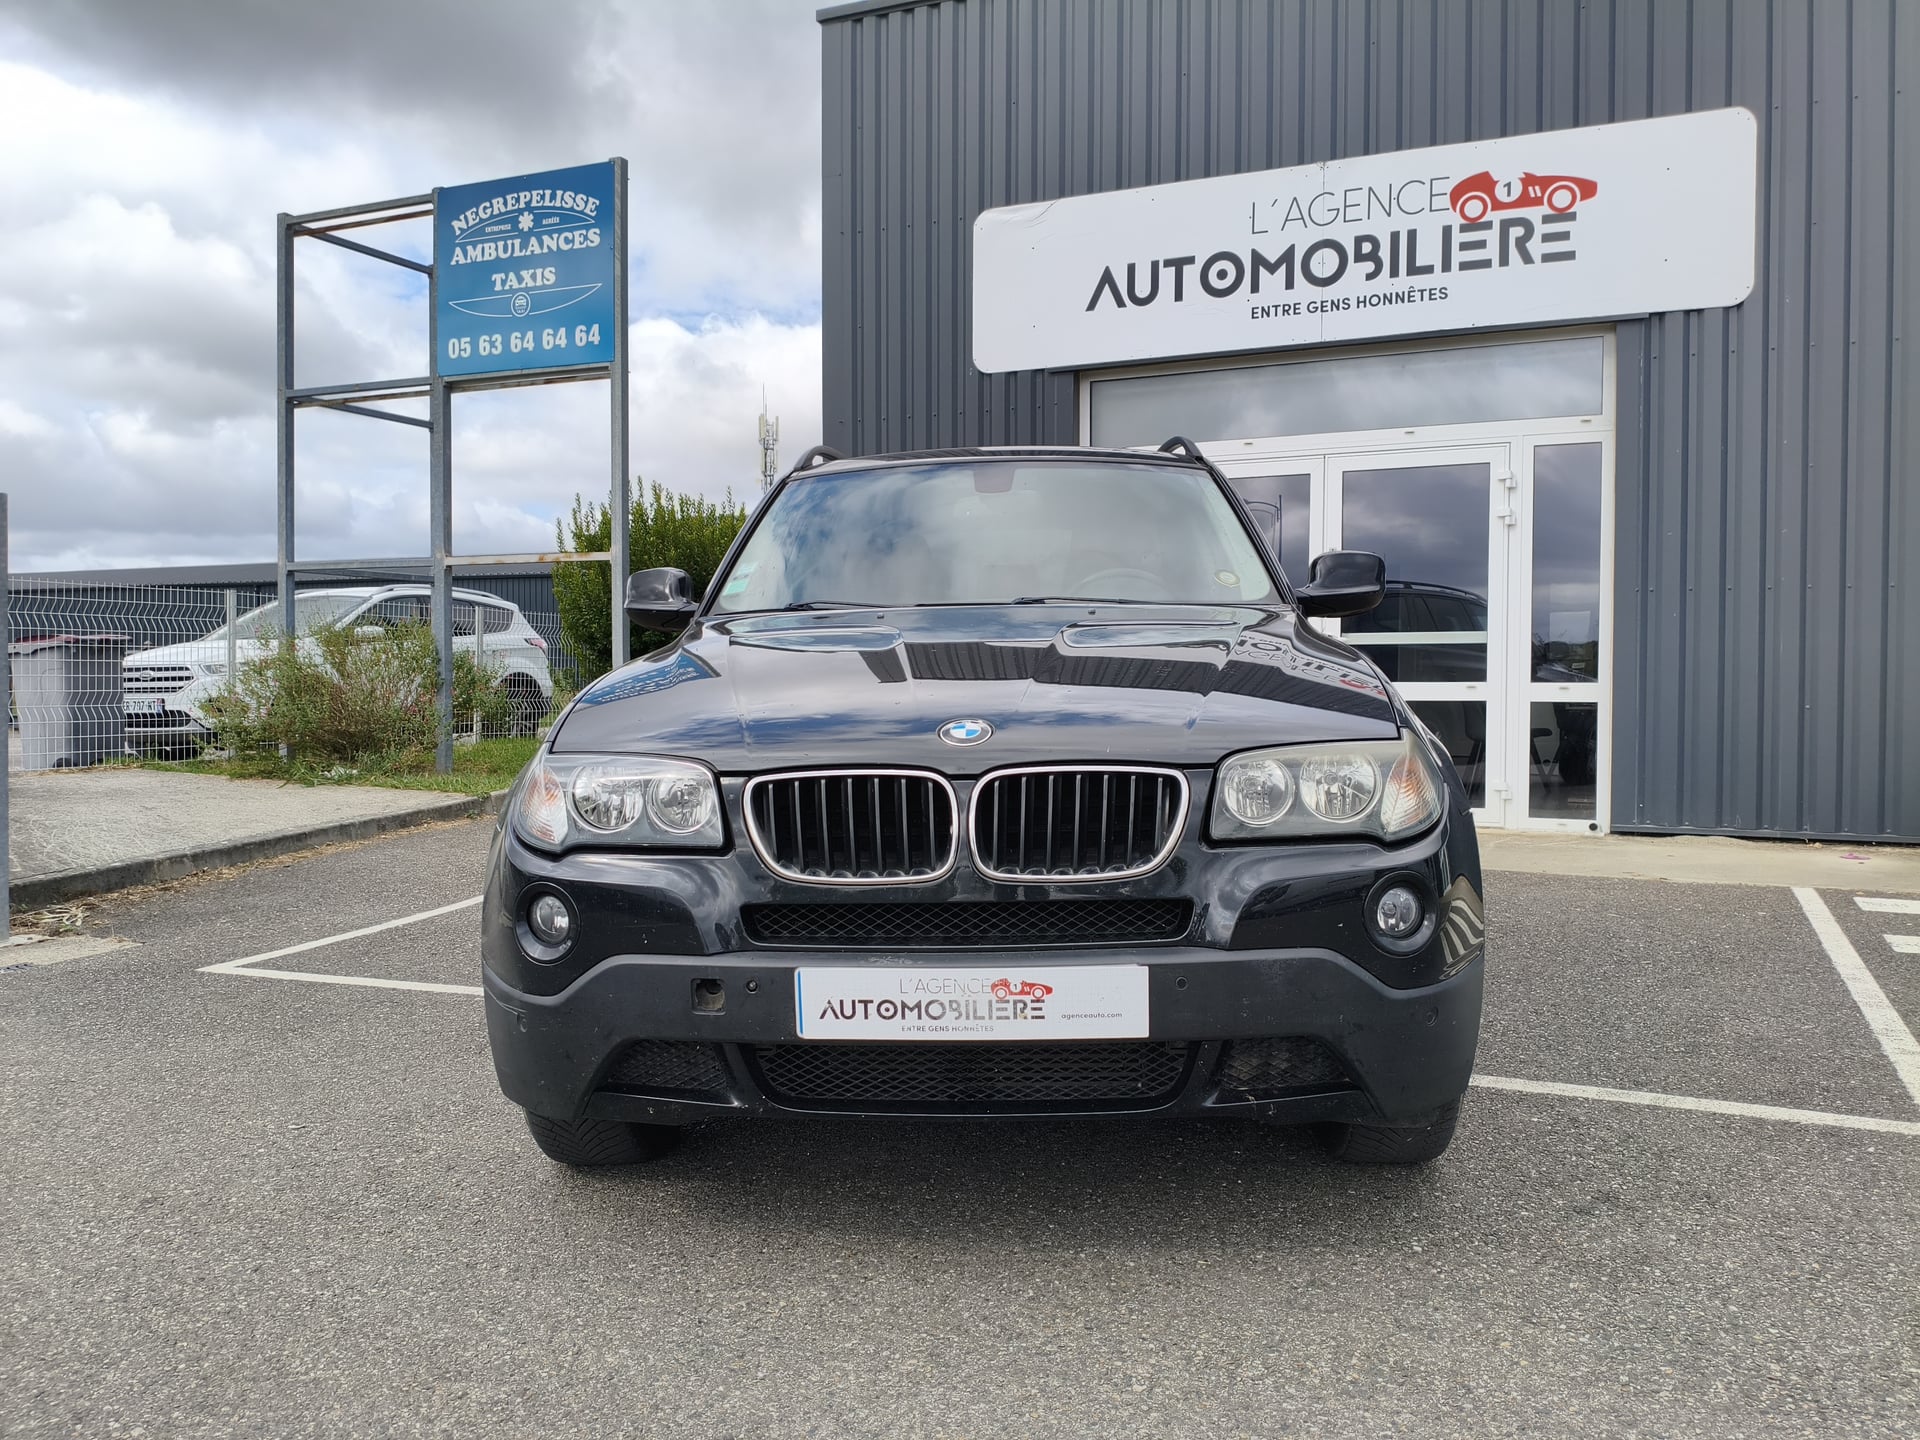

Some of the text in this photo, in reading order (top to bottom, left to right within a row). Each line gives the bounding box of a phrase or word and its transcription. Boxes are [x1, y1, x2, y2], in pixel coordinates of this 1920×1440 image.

[1503, 181, 1512, 197] 1
[452, 190, 600, 236] NEGREPELISSE
[1250, 176, 1451, 236] L'AGENCE
[451, 229, 600, 265] AMBULANCES
[491, 266, 556, 291] TAXIS
[1250, 285, 1449, 320] ENTRE GENS HONNÊTES
[448, 323, 601, 359] 05 63 64 64 64
[899, 977, 992, 995] L'AGENCE
[951, 1023, 994, 1032] HONNÊTES
[1061, 1012, 1123, 1021] agenceauto.com
